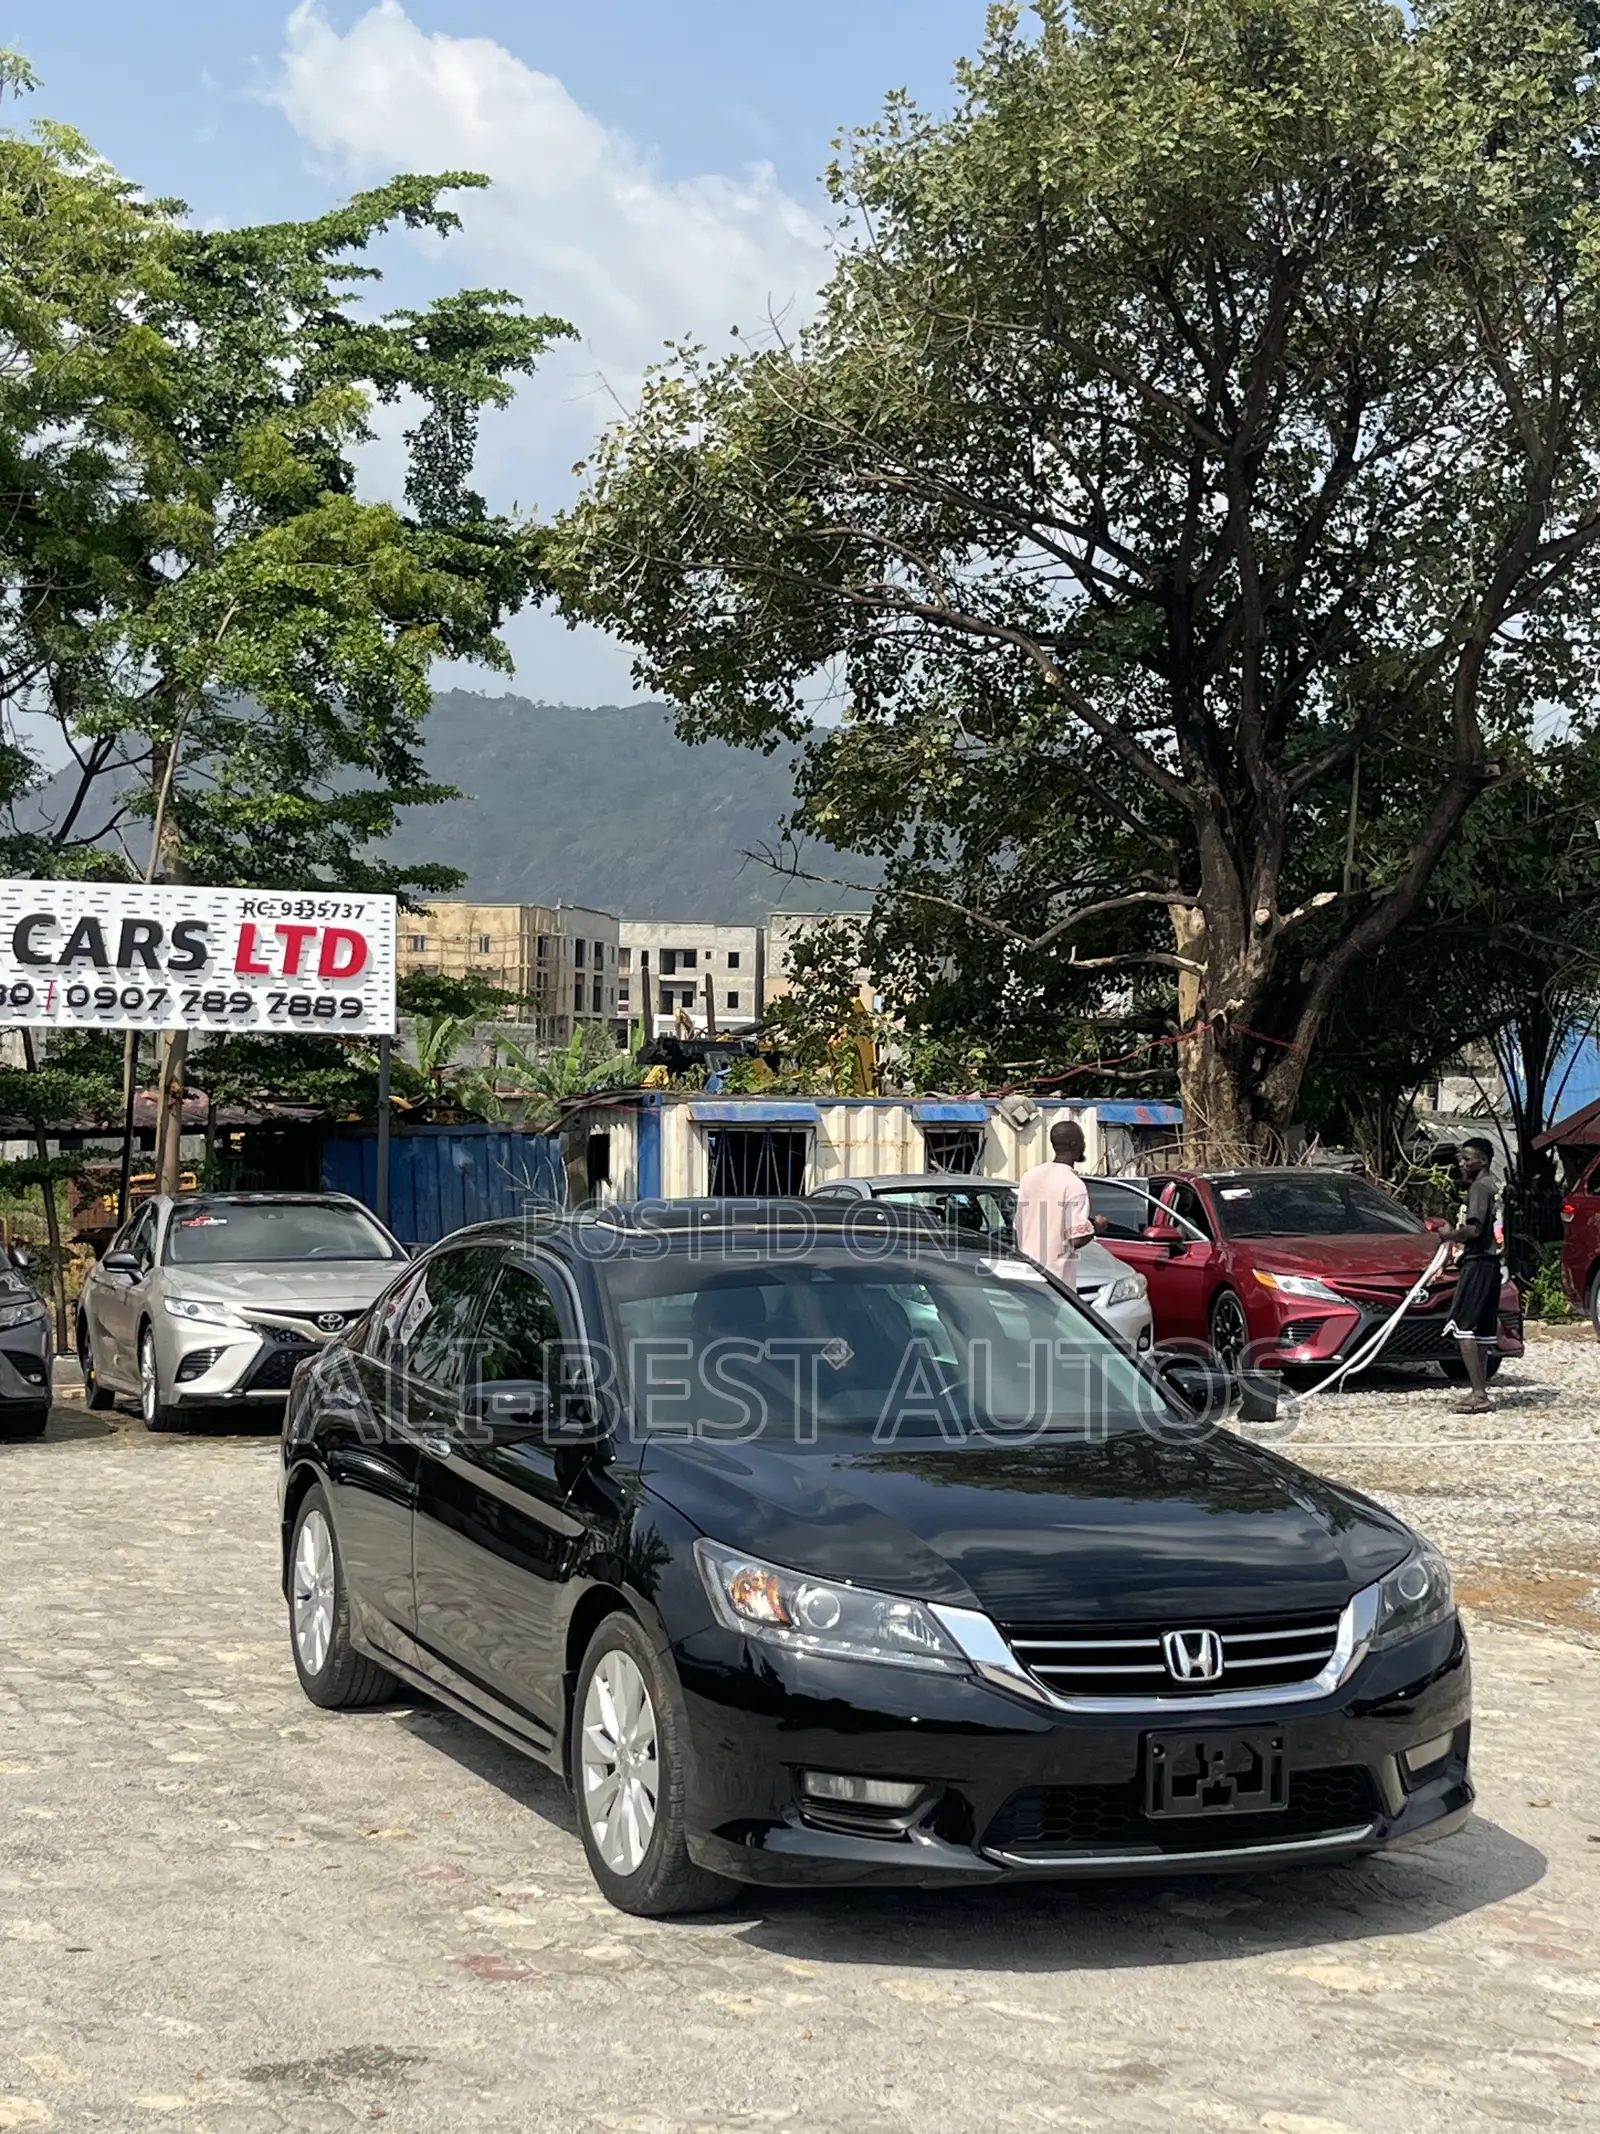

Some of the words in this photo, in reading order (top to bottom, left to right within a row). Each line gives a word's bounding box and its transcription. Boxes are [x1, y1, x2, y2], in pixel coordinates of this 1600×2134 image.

[280, 900, 365, 920] 9335737
[12, 912, 210, 971] CARS
[234, 922, 368, 978] LTD
[66, 984, 169, 1012] 0907
[179, 989, 253, 1014] 789
[266, 992, 364, 1019] 7889
